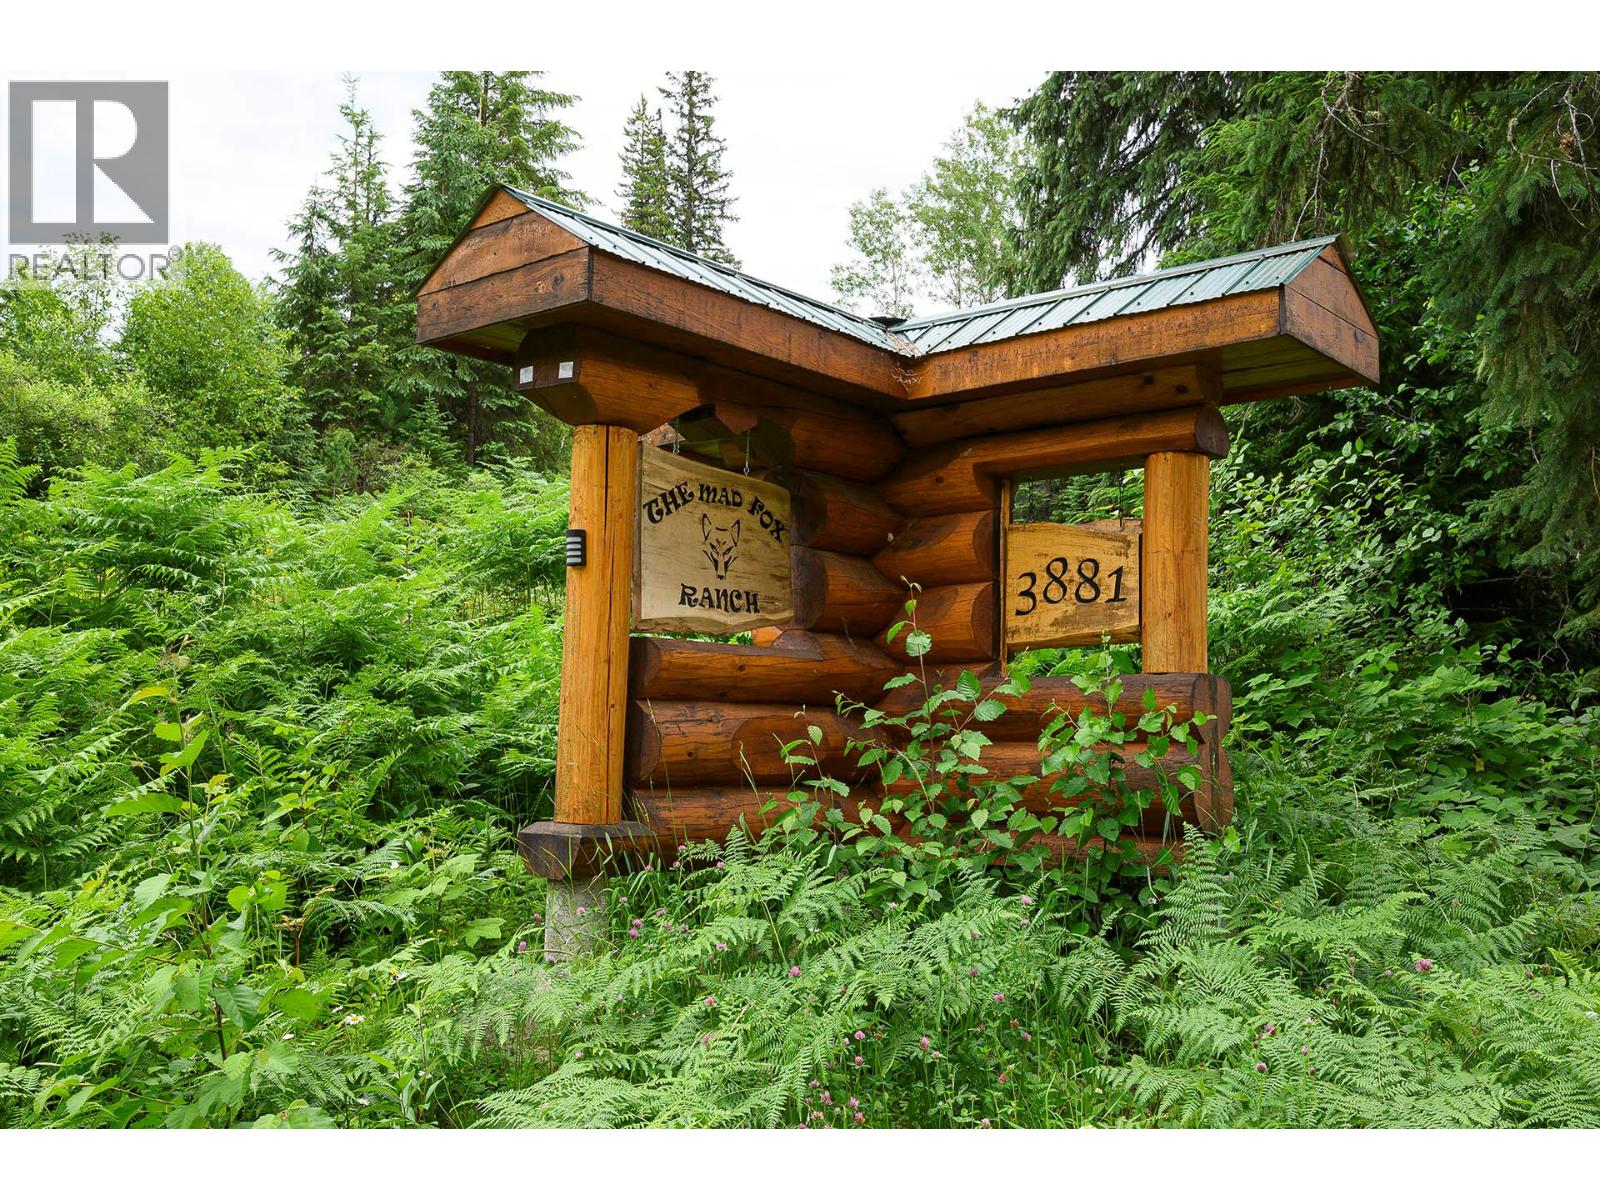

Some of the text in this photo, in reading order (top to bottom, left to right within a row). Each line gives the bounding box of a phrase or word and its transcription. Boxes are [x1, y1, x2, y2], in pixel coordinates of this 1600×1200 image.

[643, 481, 786, 544] THE MAD FOX
[678, 582, 761, 614] RANCH
[1015, 557, 1127, 616] 3881
